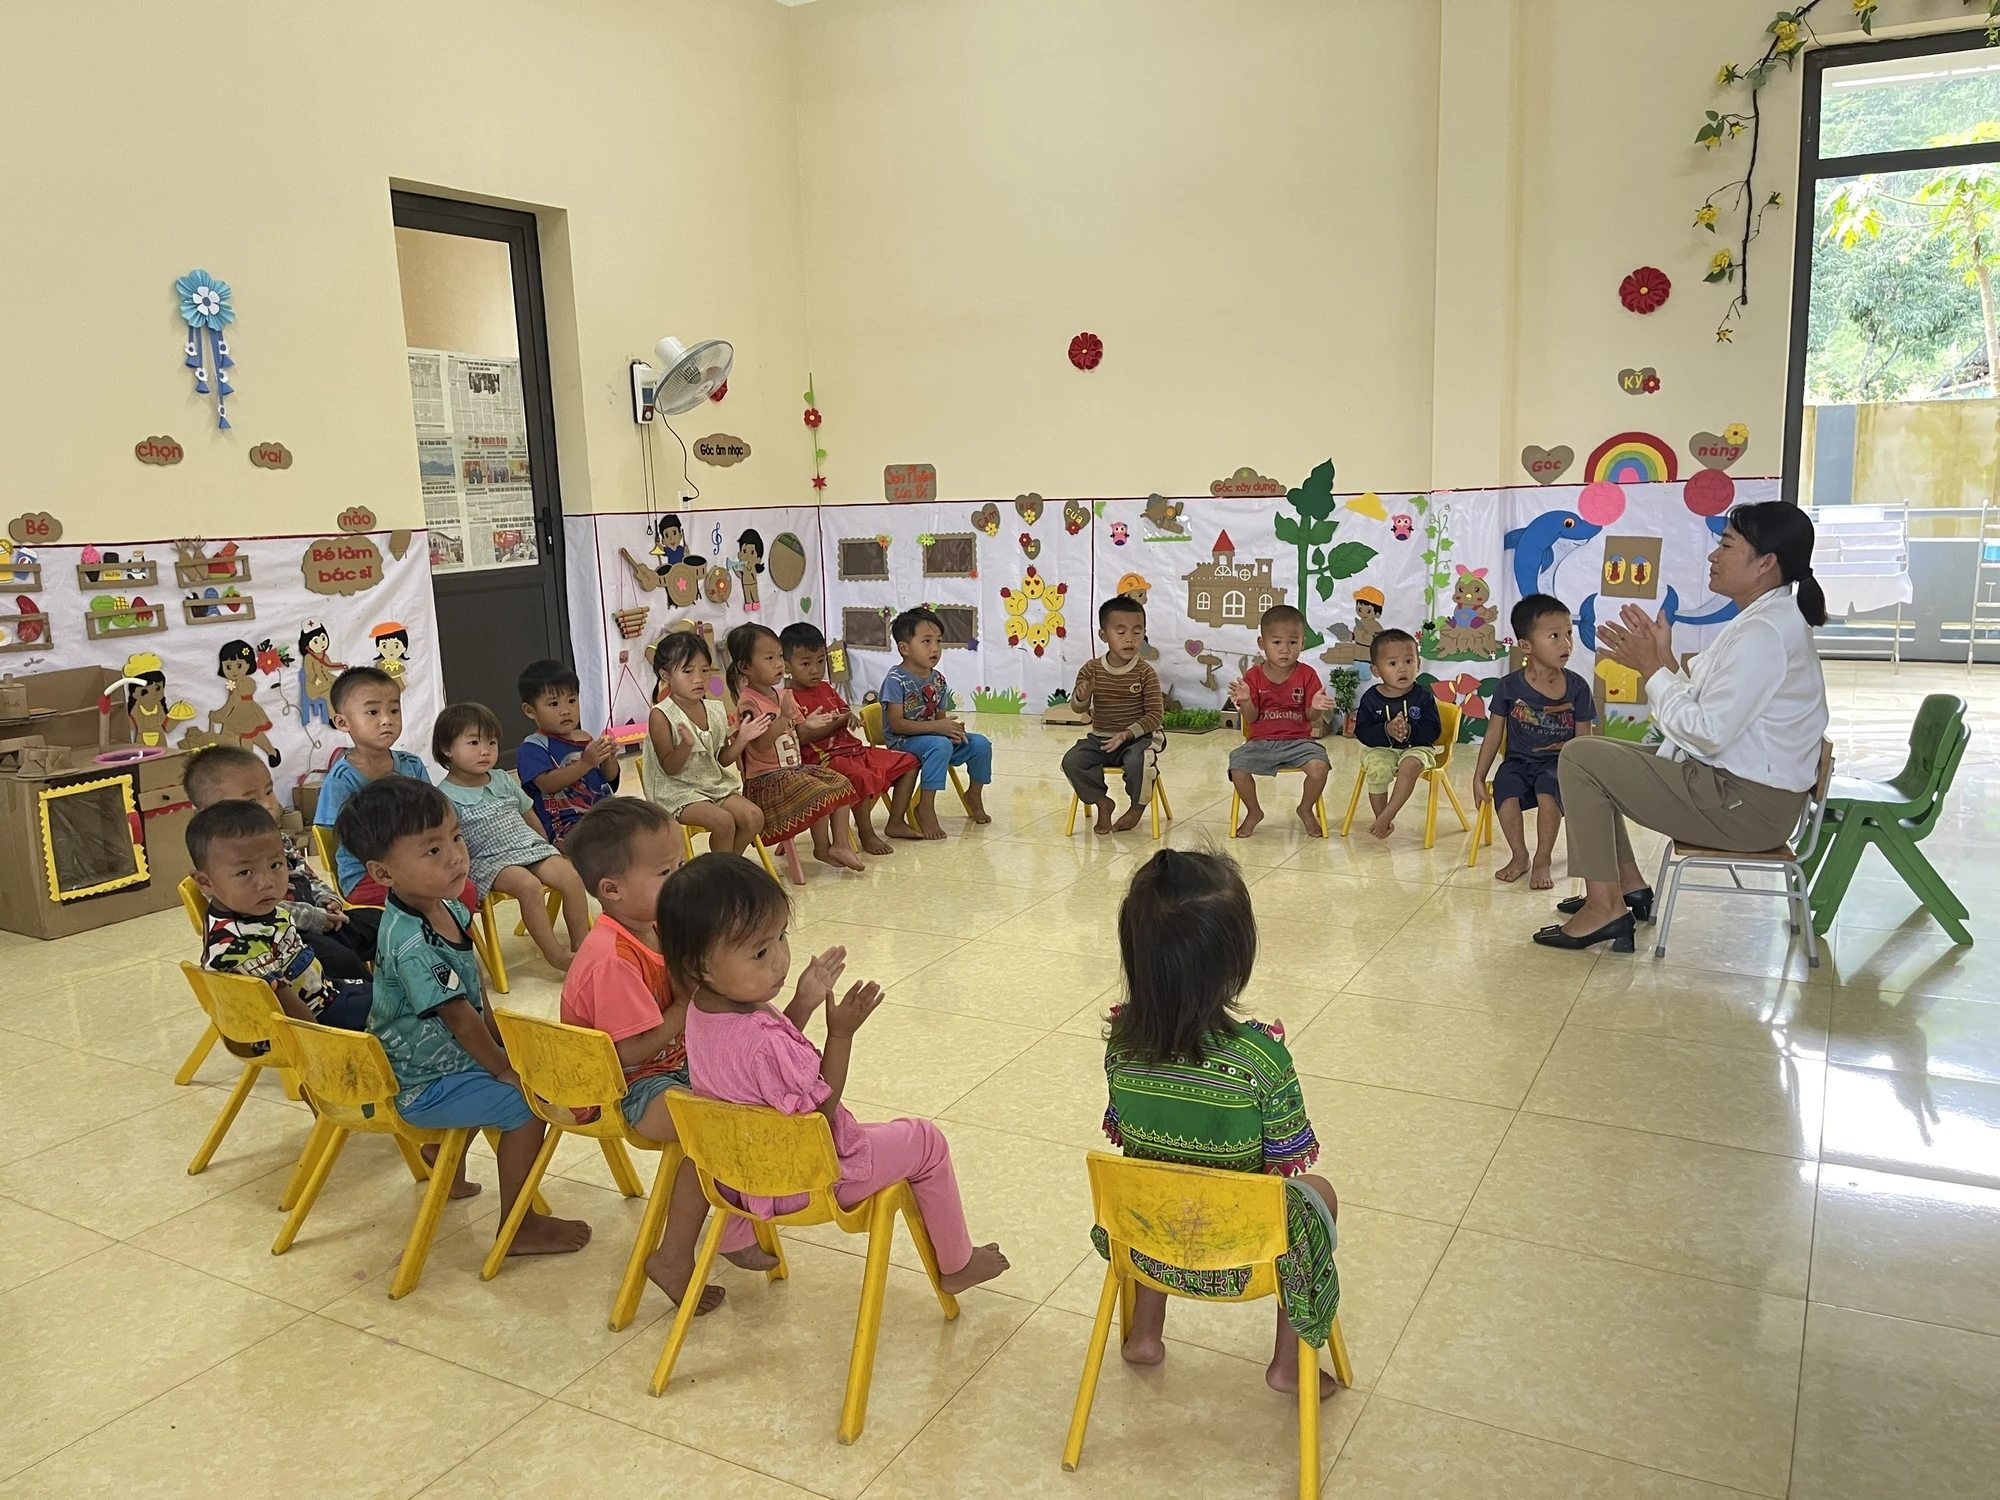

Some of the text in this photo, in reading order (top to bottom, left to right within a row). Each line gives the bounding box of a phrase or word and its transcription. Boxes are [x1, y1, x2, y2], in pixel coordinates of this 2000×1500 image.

[137, 442, 182, 461] chọn
[700, 443, 715, 456] Góc
[728, 444, 744, 458] nhạc
[1697, 443, 1741, 461] năng
[1214, 481, 1277, 494] Góc xây dựng
[343, 511, 372, 526] nào
[26, 518, 50, 536] Bé
[312, 546, 373, 562] Bé làm
[318, 565, 373, 583] bác sĩ
[1262, 710, 1303, 723] Rakuten
[435, 964, 450, 974] MLS
